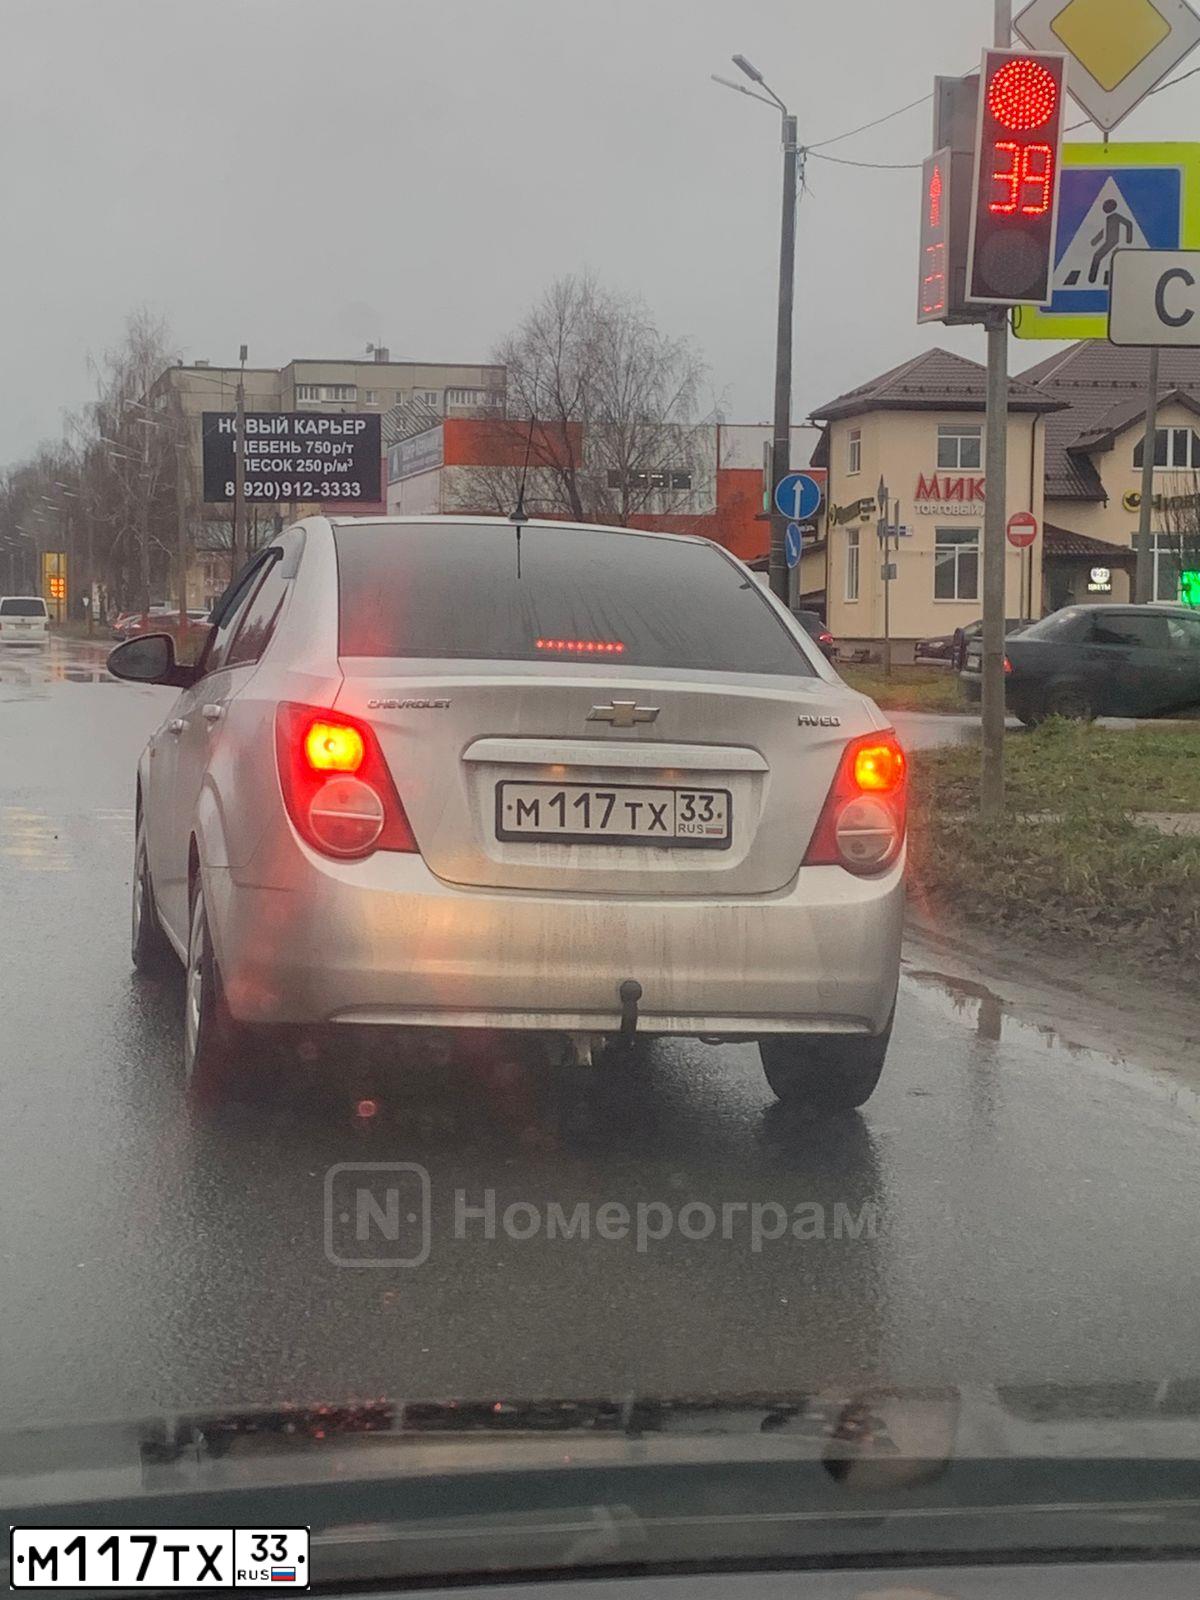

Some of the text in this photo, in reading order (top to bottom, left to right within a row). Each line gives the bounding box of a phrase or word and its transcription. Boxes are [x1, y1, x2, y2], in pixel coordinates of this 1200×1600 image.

[988, 142, 1051, 214] 39
[294, 419, 367, 435] КАРЬЕР
[224, 481, 361, 500] 8920)912-3333
[914, 502, 980, 516] ТОРГОВЫЙ
[367, 698, 453, 709] CHEVROLET
[797, 714, 841, 727] AVEO
[680, 794, 715, 822] 33
[678, 823, 704, 834] RUS
